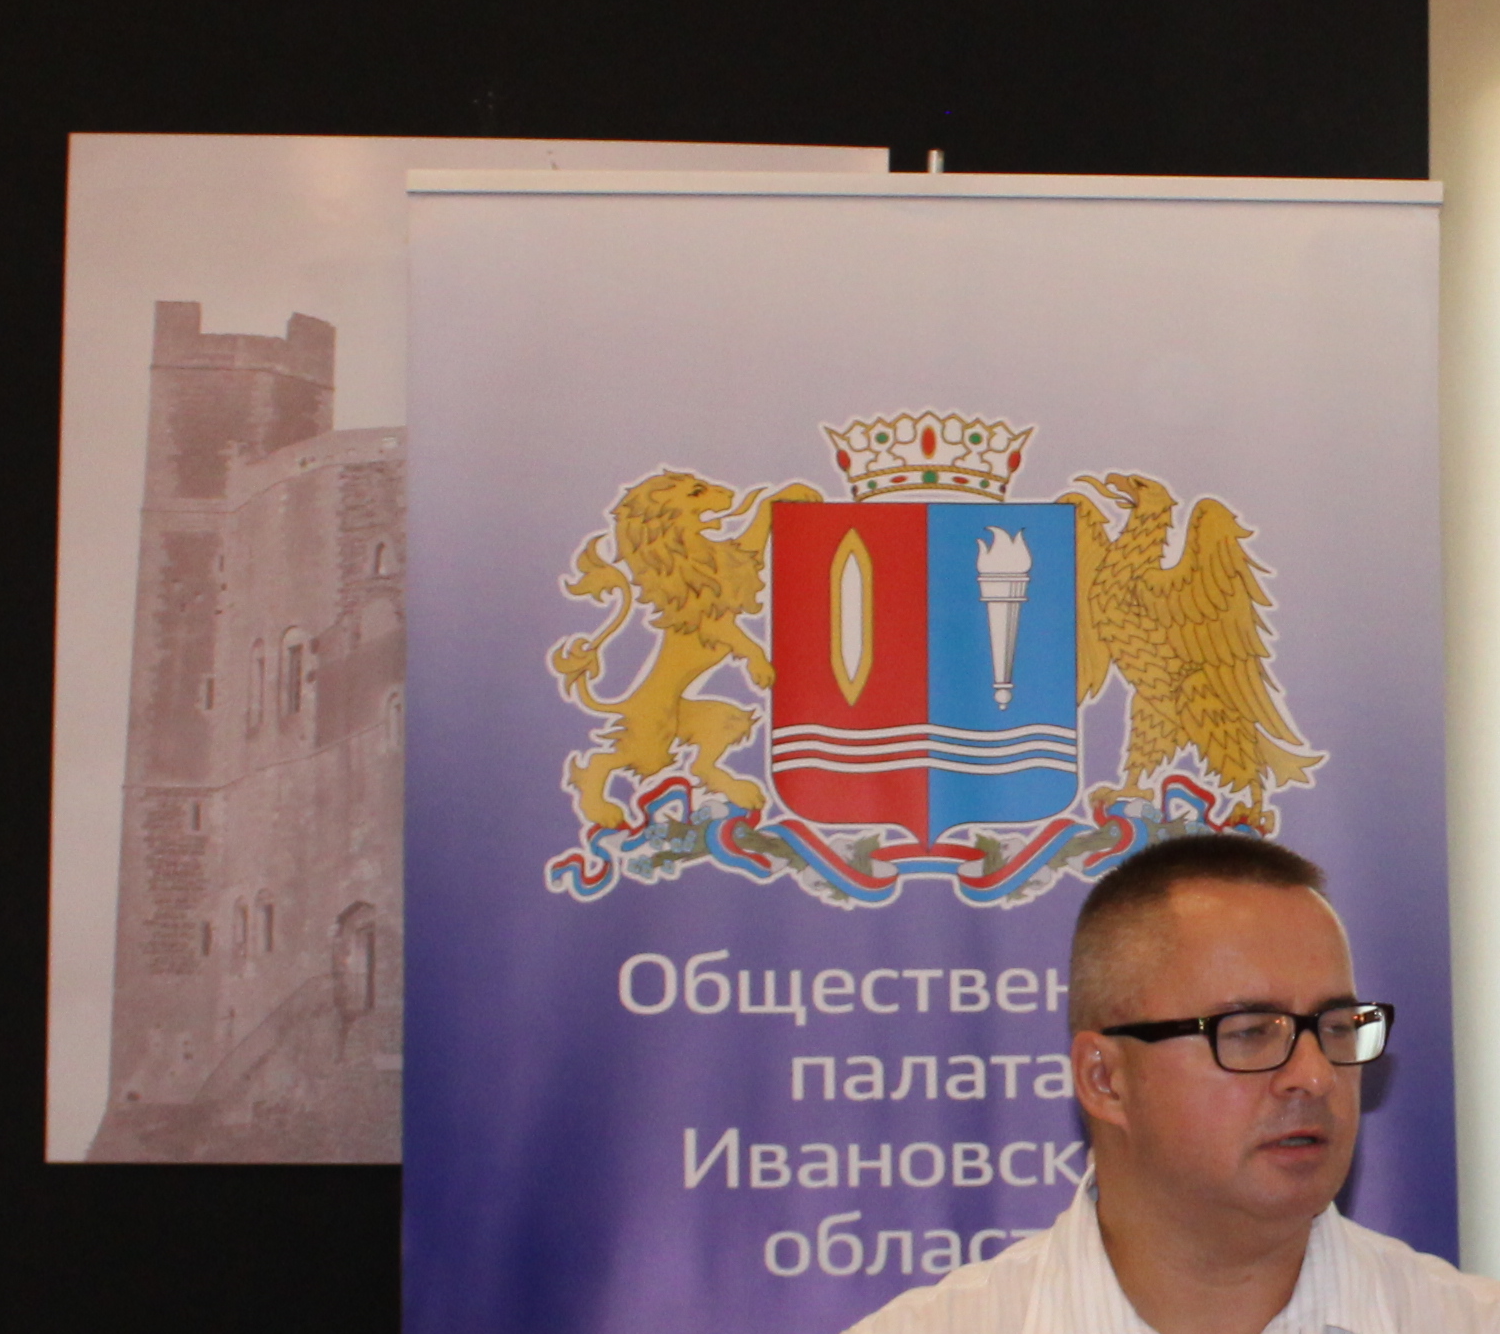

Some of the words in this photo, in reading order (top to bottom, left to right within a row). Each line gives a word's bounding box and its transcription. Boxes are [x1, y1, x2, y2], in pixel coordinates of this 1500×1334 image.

[790, 1053, 1074, 1101] палата
[682, 1127, 1084, 1189] Ивановск
[763, 1211, 1043, 1277] облас
